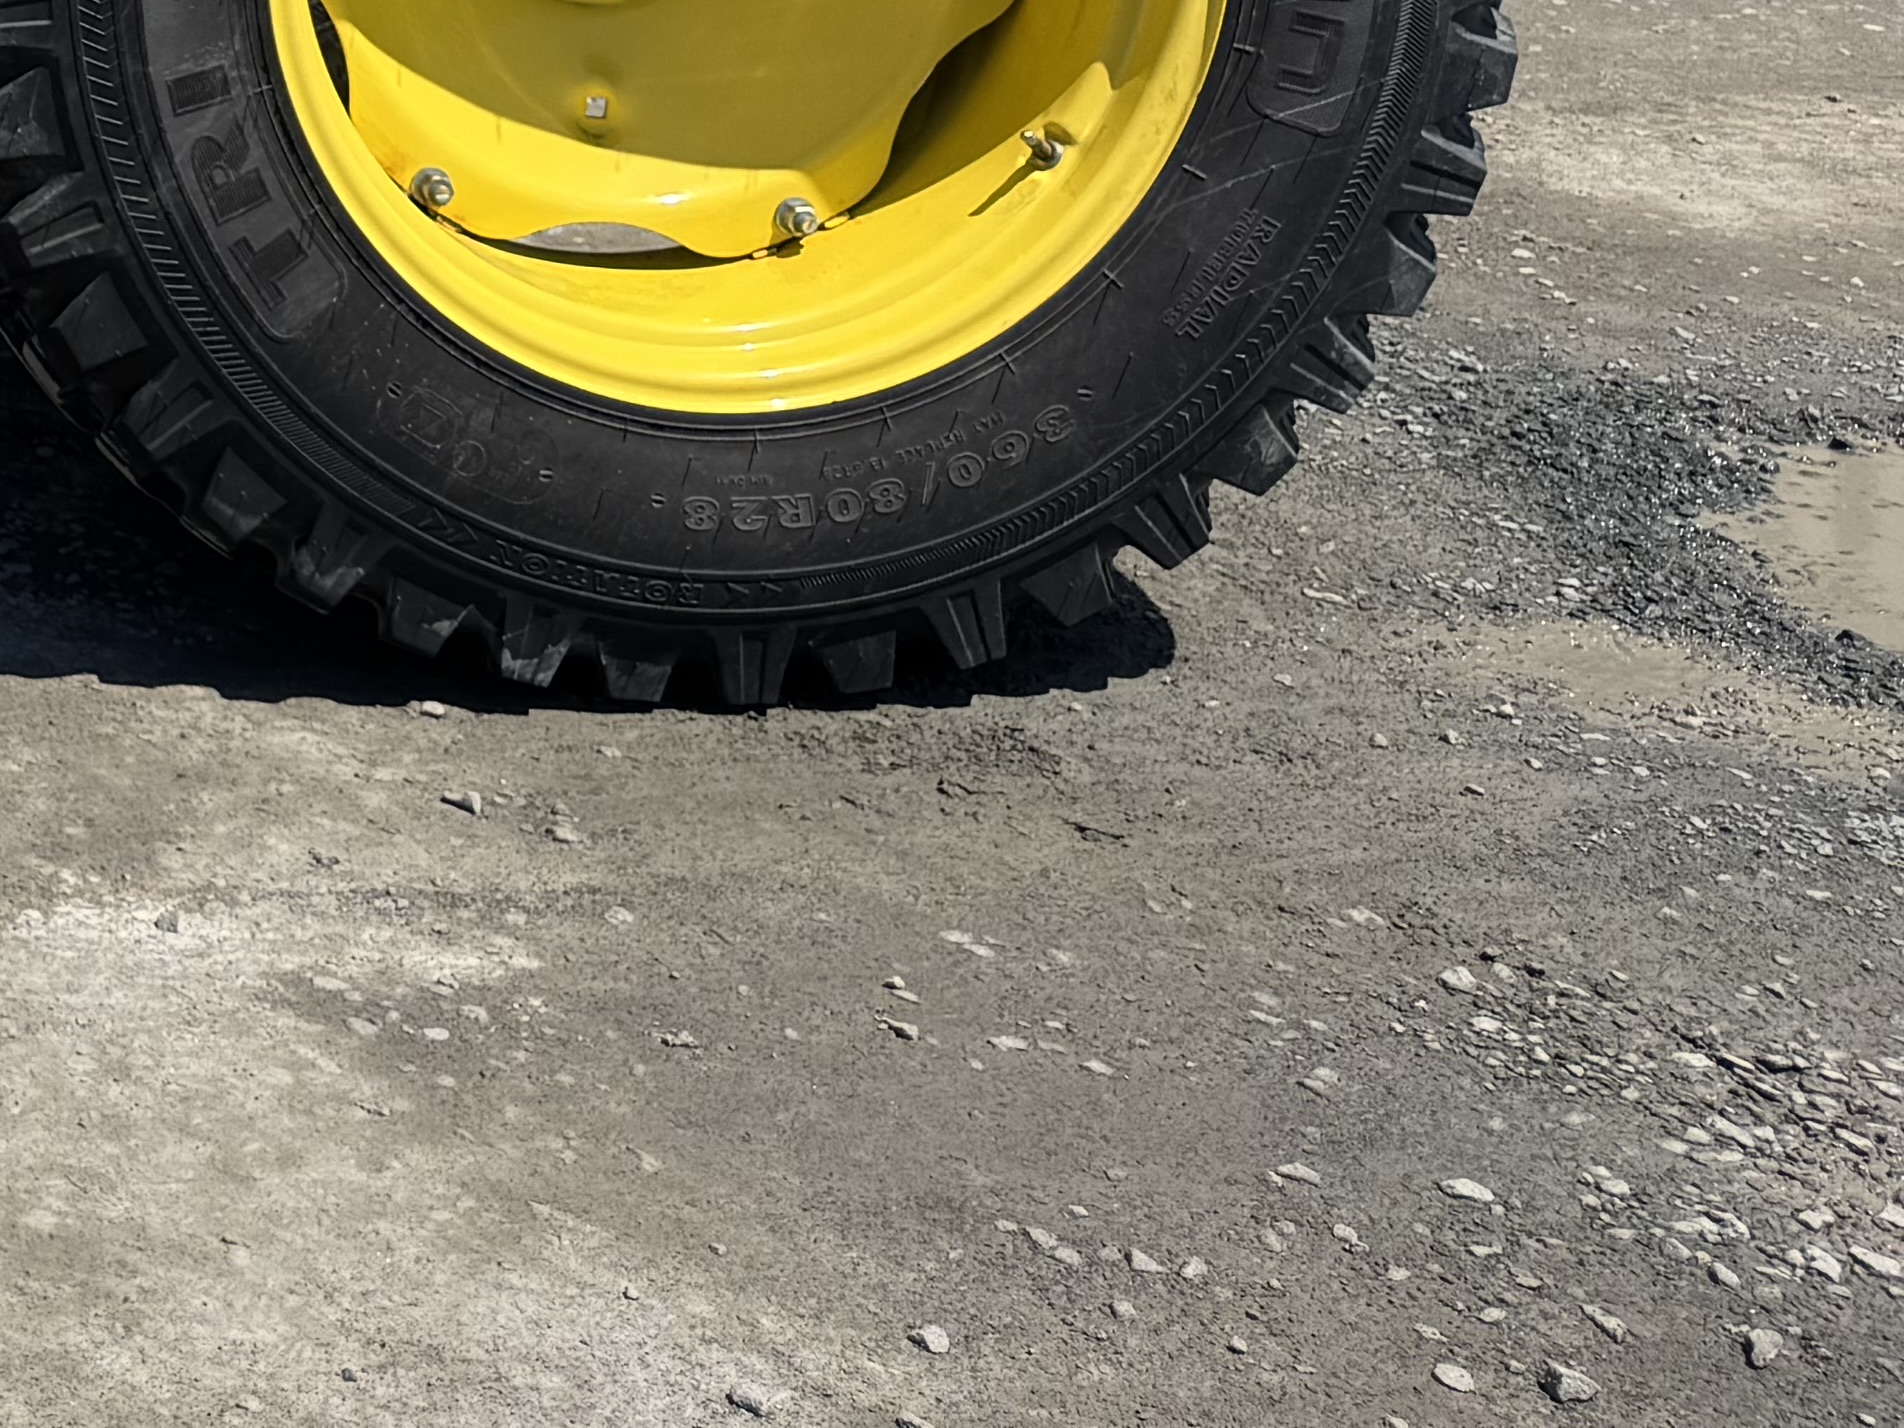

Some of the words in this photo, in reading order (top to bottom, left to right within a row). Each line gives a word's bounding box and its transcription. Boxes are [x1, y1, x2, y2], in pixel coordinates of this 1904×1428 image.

[161, 64, 318, 312] TRI
[1160, 207, 1261, 328] TUBELESS
[1176, 213, 1282, 341] RADIAL
[681, 404, 1078, 532] 360/80R28
[491, 536, 704, 609] ROTATION
